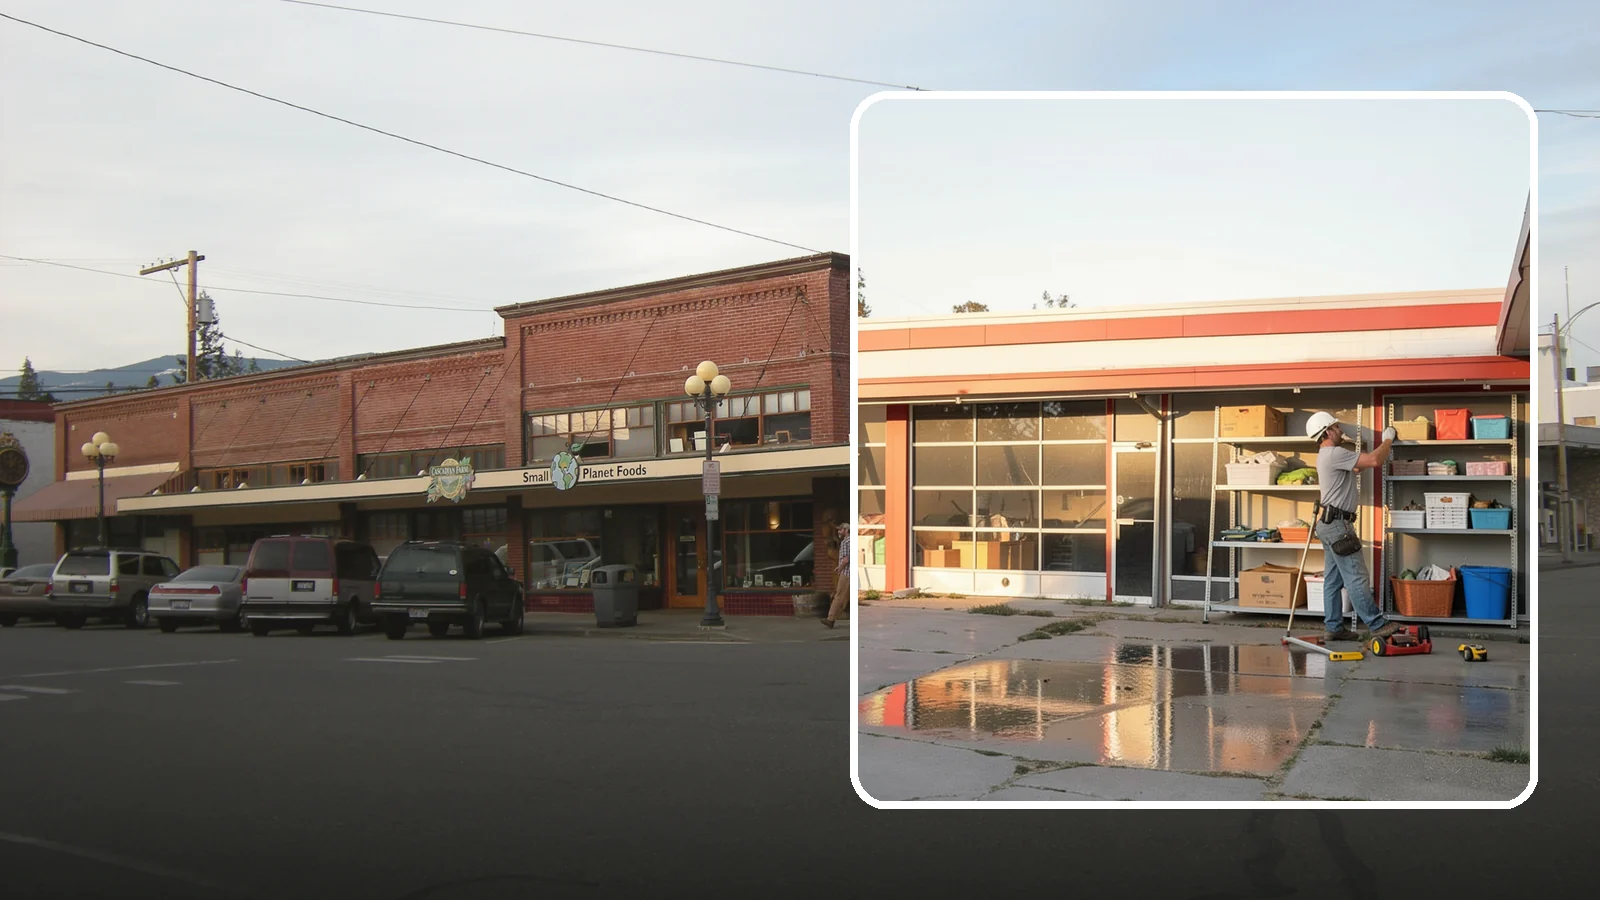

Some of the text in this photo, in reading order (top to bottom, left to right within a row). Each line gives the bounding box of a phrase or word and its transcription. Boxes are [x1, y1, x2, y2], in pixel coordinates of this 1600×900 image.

[431, 466, 469, 475] CASCADIAN FARM
[523, 464, 647, 483] Small Planet Foods
